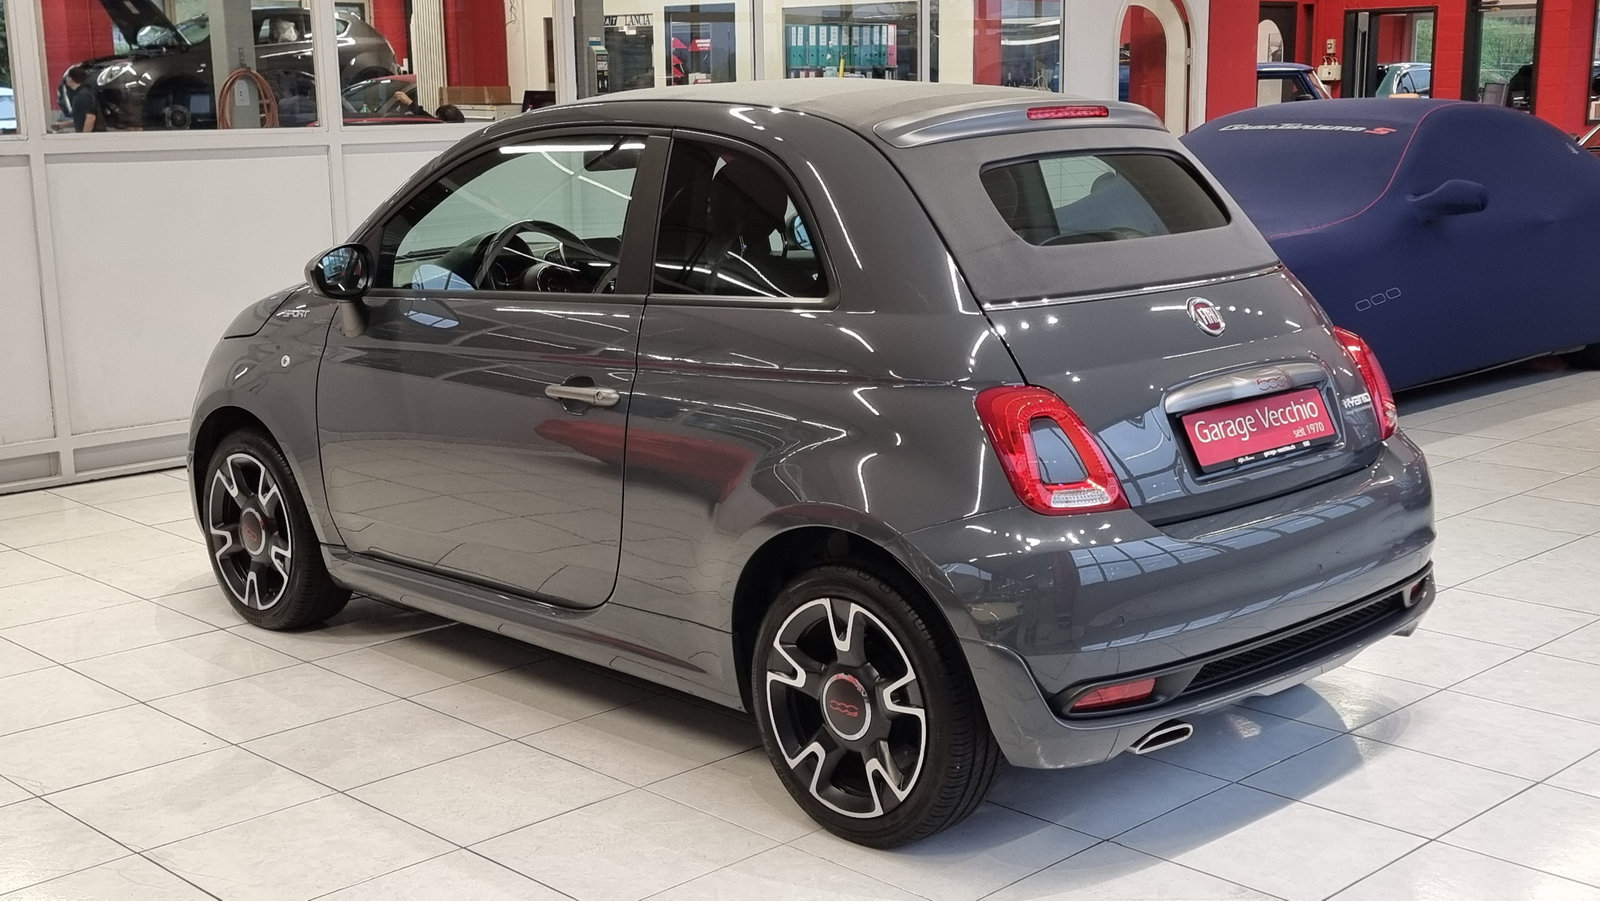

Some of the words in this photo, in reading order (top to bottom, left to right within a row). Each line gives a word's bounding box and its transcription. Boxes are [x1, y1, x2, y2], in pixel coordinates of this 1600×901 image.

[1194, 415, 1258, 442] Garage
[1255, 398, 1319, 429] Vecchio
[1293, 426, 1306, 439] seit
[1306, 422, 1325, 435] 1970
